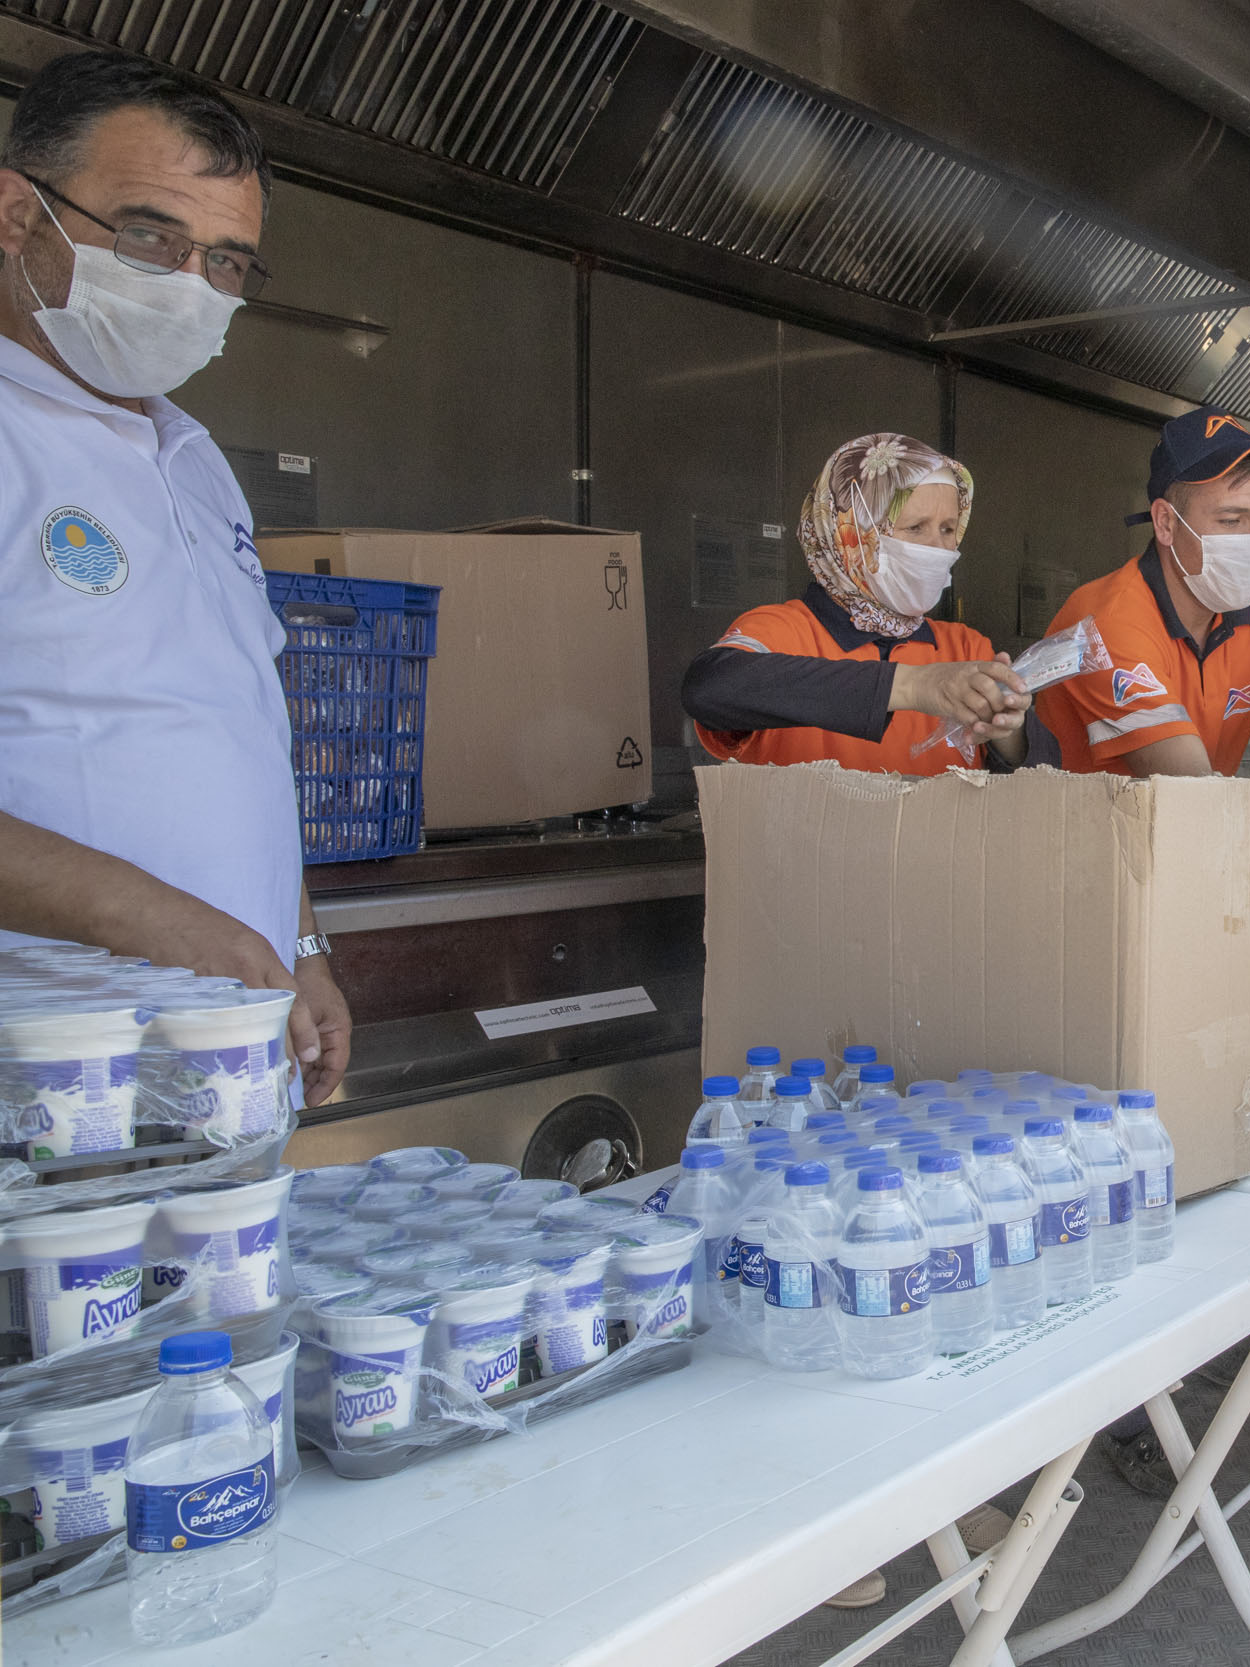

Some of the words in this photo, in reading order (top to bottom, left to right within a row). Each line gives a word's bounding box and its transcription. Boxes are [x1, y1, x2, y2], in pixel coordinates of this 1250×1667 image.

[549, 1004, 581, 1016] optima
[83, 1279, 141, 1338] Ayra
[951, 1346, 1000, 1371] MERSİN
[996, 1311, 1062, 1347] BÜYÜKŞEHİR
[957, 1342, 1028, 1378] MEZARLIKLAR
[1026, 1320, 1065, 1344] DAİRESİ
[335, 1385, 397, 1428] Ayran
[190, 1496, 261, 1528] Bahçepınar
